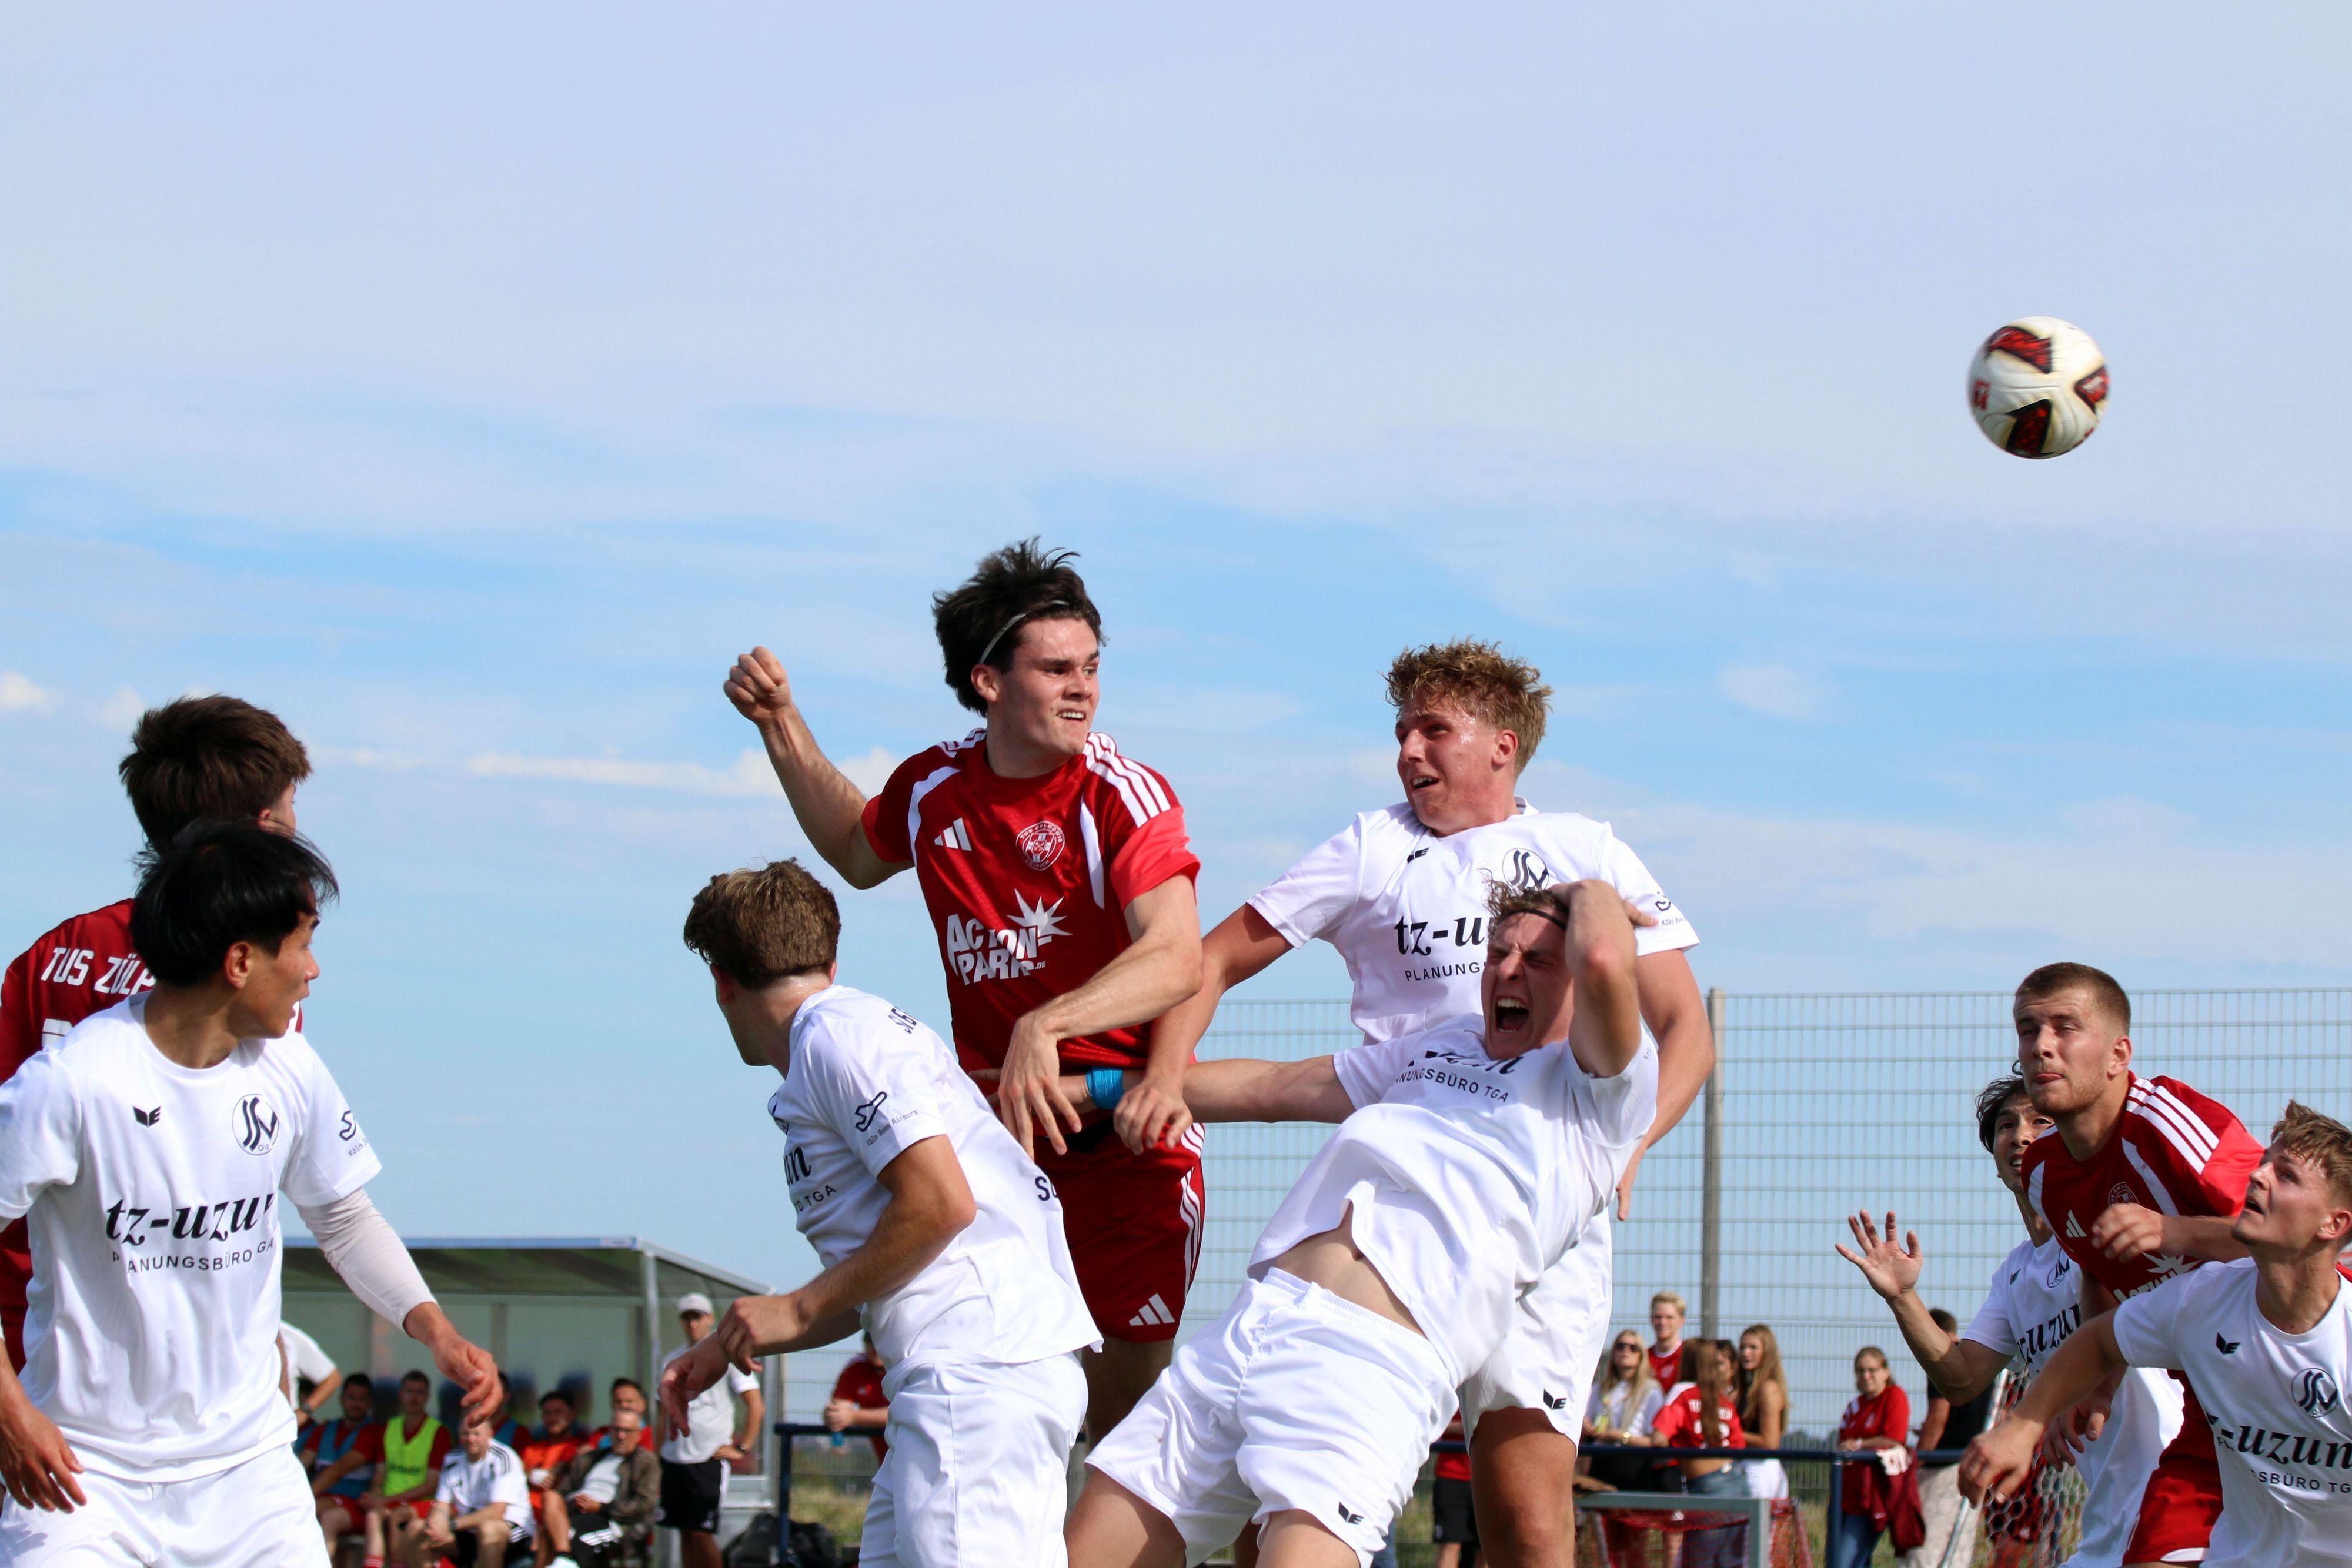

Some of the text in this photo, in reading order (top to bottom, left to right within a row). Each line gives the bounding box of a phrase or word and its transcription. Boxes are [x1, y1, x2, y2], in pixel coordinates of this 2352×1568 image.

[1394, 915, 1489, 957] tz-u
[40, 947, 157, 995] TUS ZÜLP
[1404, 961, 1487, 982] PLANUNG
[1484, 1085, 1509, 1103] TGA
[804, 1184, 837, 1207] TGA
[112, 1238, 273, 1274] PANUNGSBÜRO GA
[2328, 1482, 2351, 1493] TG
